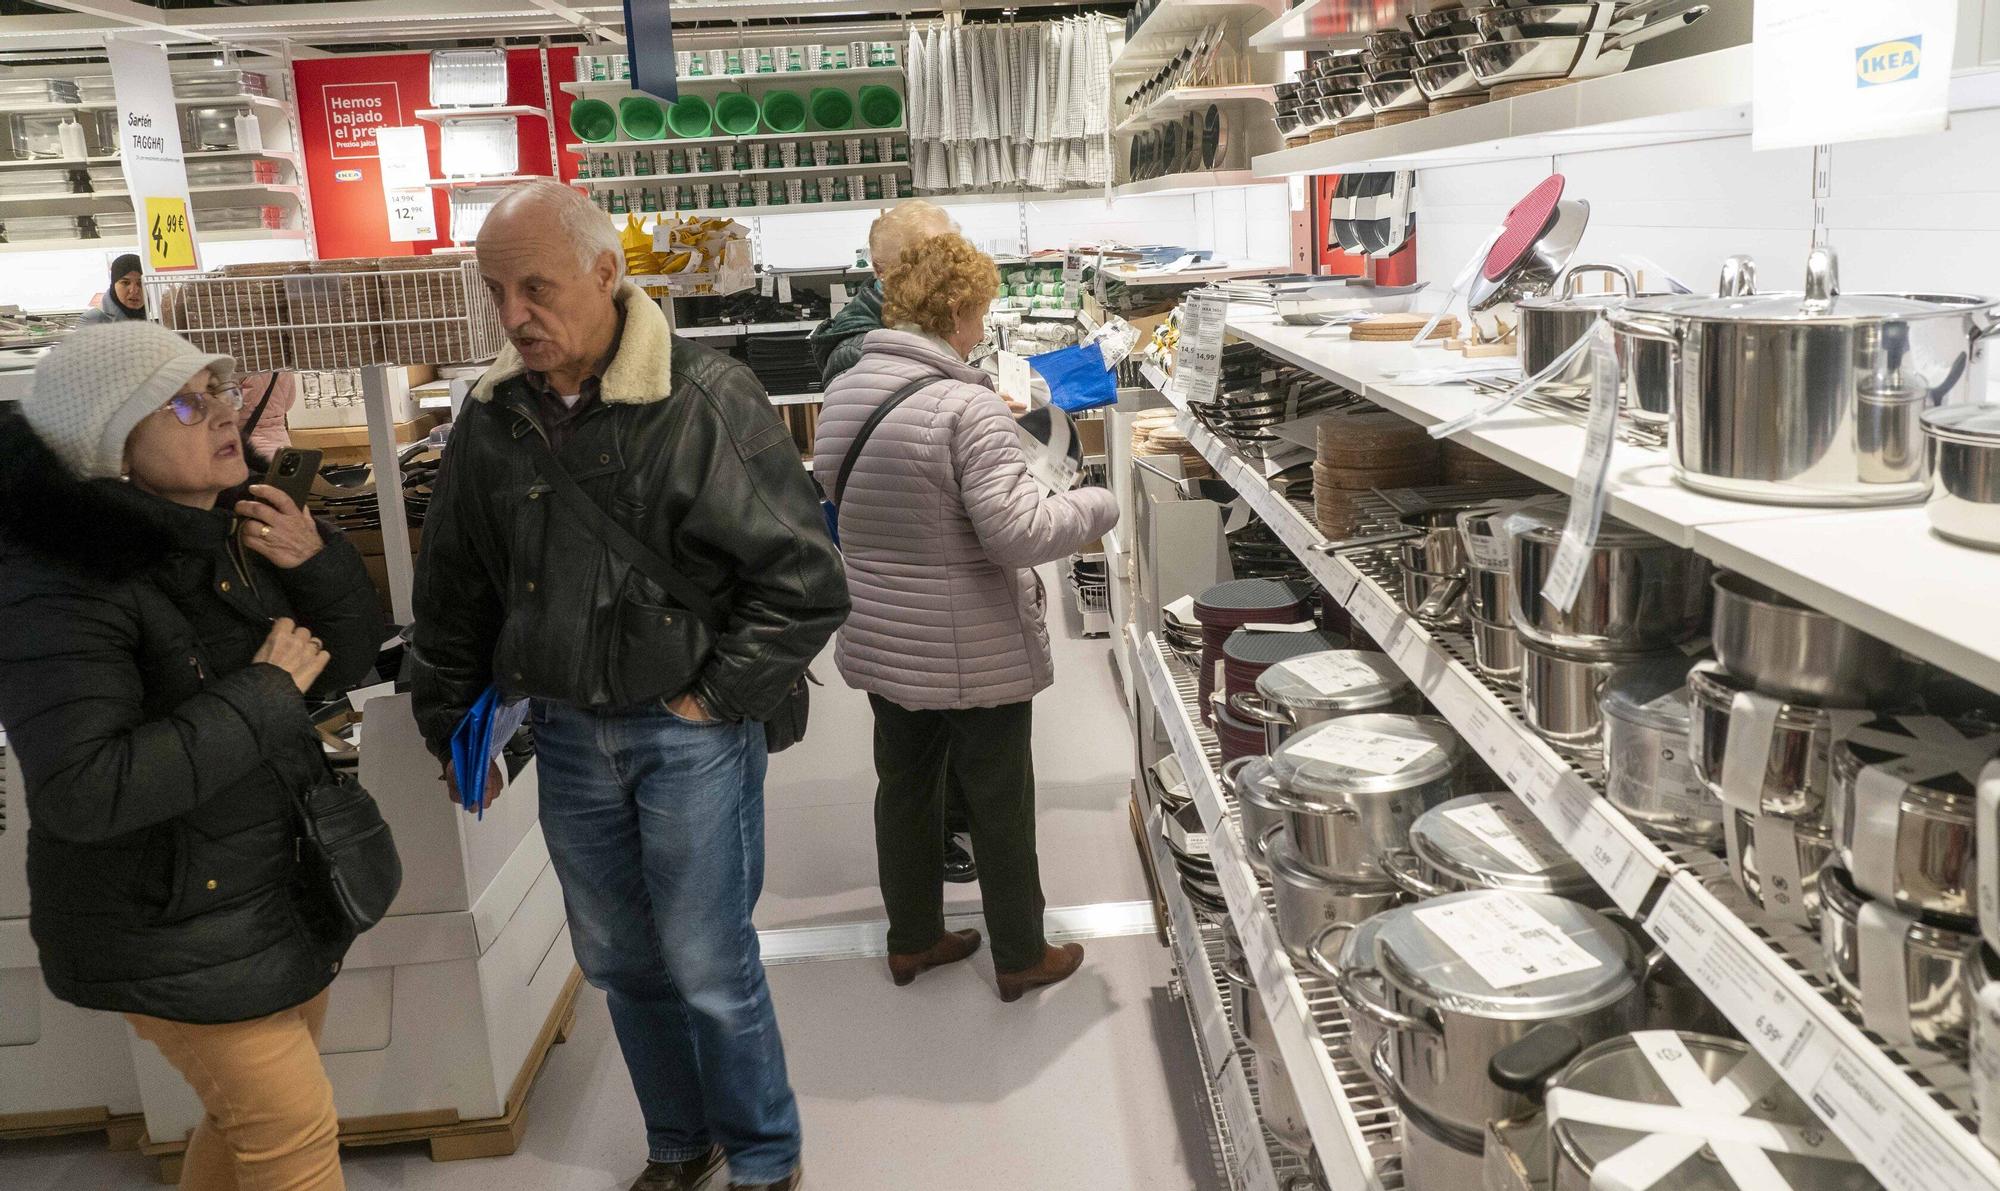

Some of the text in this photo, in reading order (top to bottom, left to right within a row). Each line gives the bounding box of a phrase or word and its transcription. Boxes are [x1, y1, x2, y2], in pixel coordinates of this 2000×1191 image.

[1862, 50, 1914, 74] IKEA
[331, 97, 382, 109] Hemos
[128, 112, 151, 128] Sartén
[333, 110, 383, 126] bajado
[335, 125, 348, 138] el
[133, 135, 164, 153] TAGGHAJ
